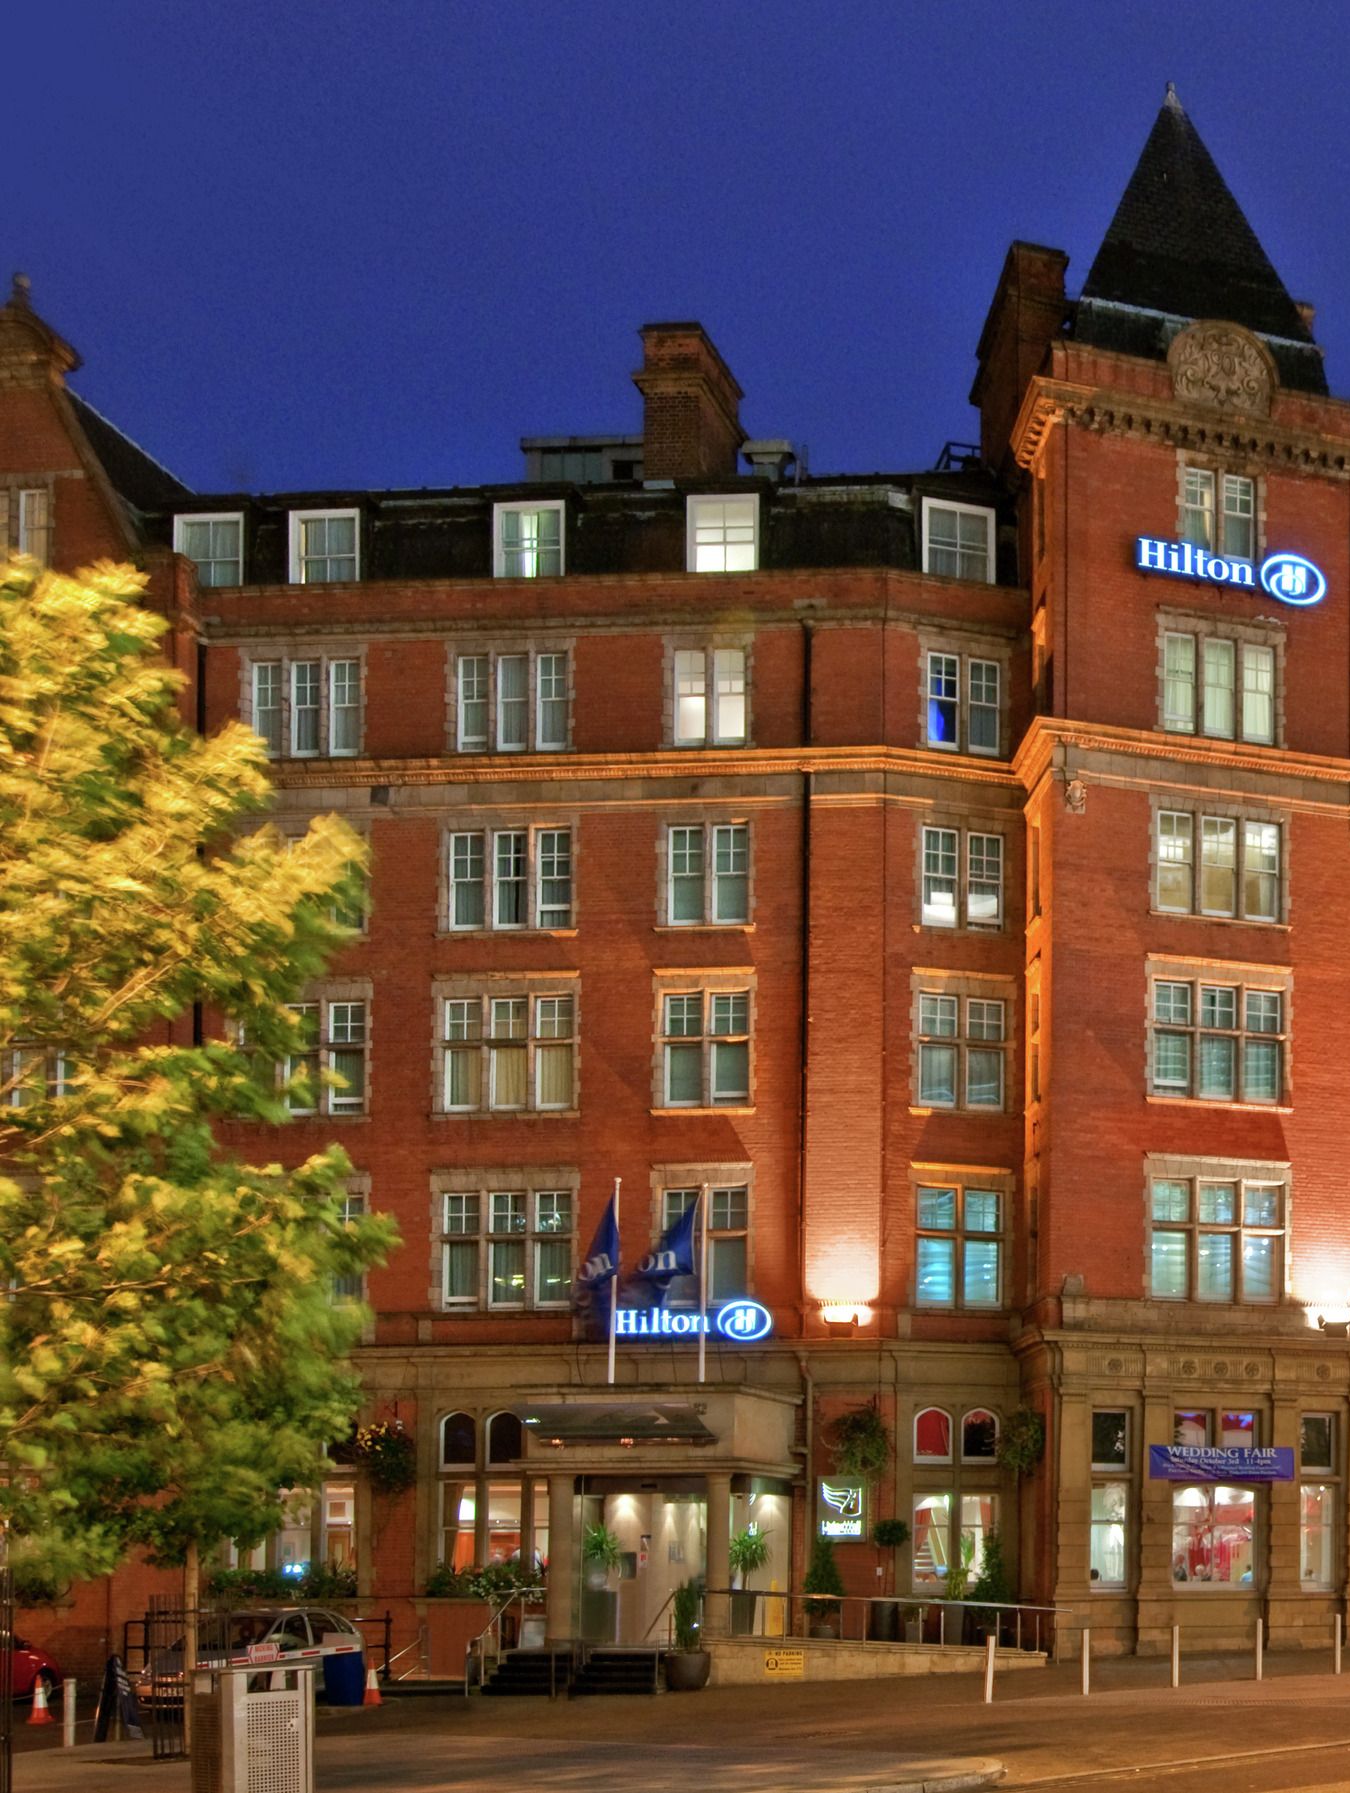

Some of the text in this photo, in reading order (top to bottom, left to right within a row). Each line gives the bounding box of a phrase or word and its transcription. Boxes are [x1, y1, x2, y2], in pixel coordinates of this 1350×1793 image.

[1138, 538, 1255, 586] Hilton
[615, 1308, 710, 1334] Hilton
[1167, 1446, 1278, 1458] WEDDING FAIR
